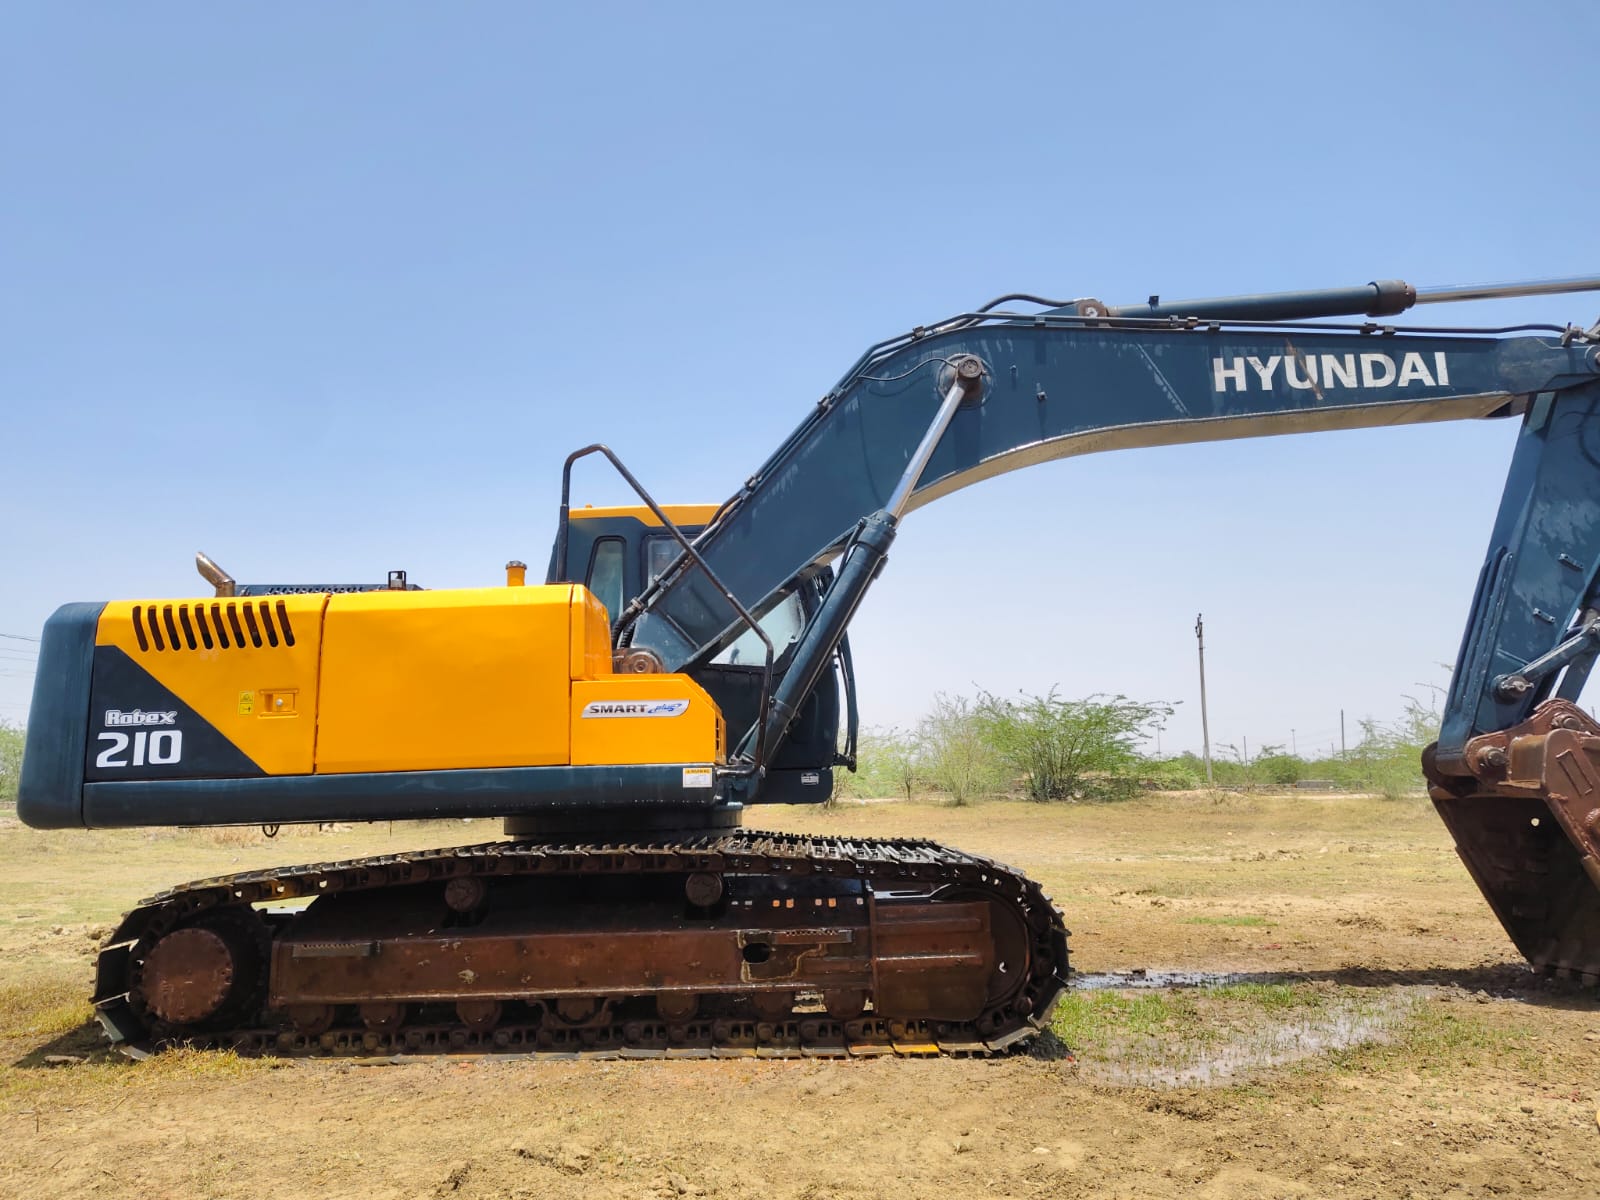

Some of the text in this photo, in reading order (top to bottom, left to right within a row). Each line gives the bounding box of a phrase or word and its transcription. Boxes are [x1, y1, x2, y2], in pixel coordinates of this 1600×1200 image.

[1213, 352, 1449, 392] HYUNDAI
[105, 709, 177, 727] Robex
[590, 703, 678, 713] SMART plus
[96, 730, 182, 767] 210
